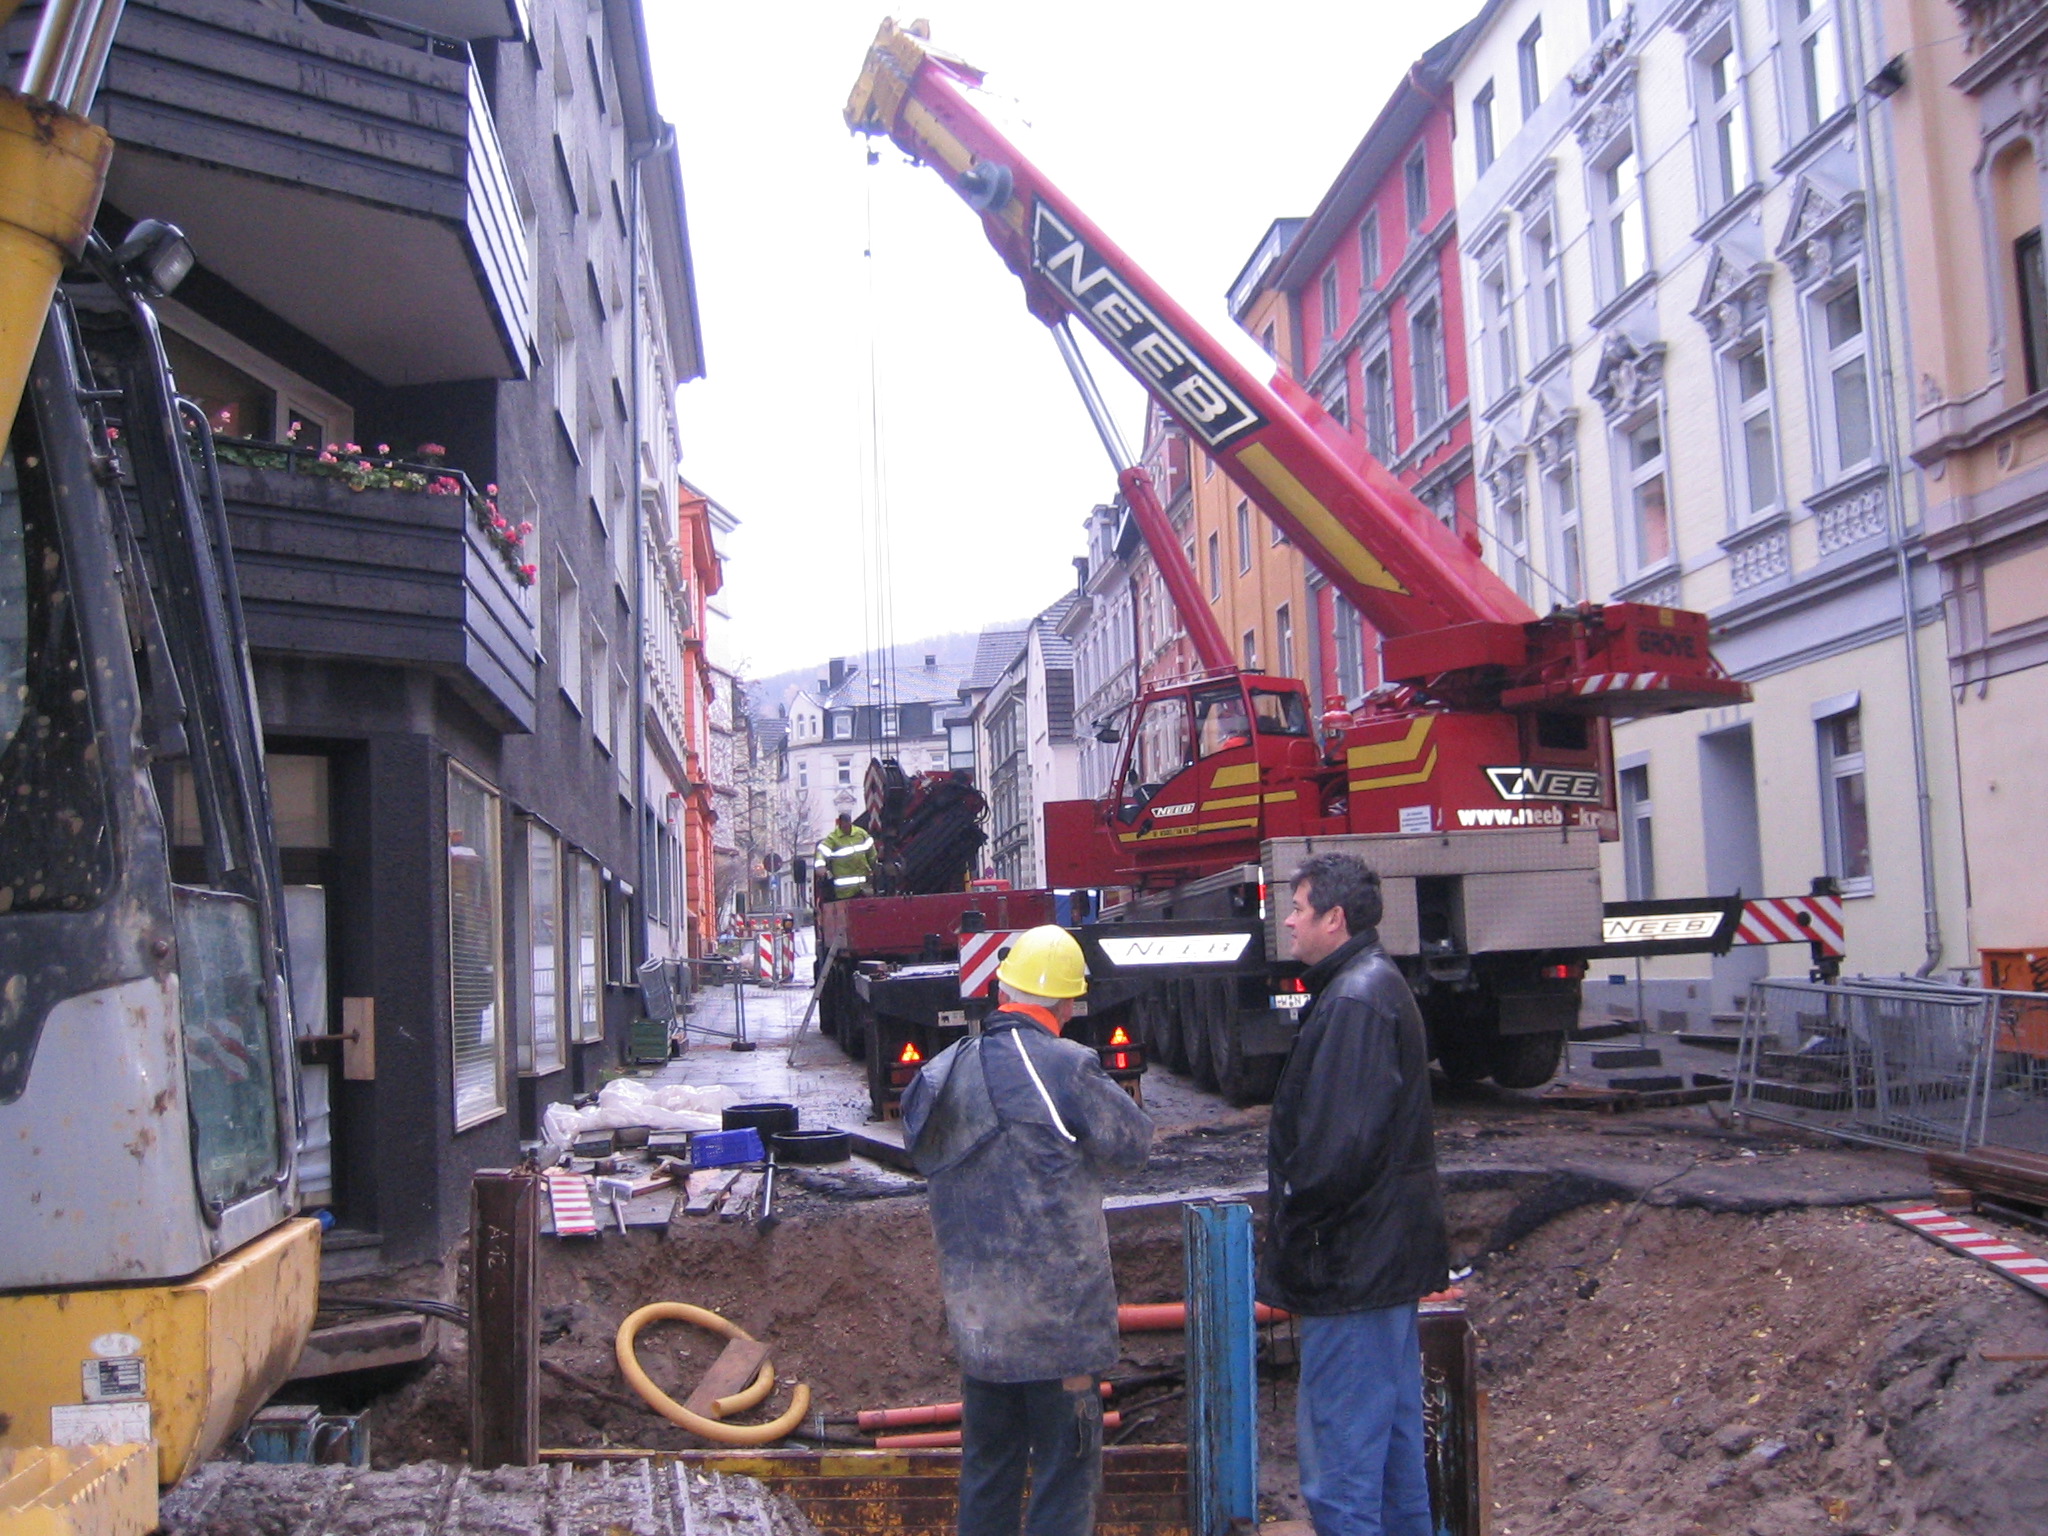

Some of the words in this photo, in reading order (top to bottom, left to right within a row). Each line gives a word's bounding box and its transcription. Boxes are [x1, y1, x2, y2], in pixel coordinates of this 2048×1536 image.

[1046, 239, 1228, 423] NEEB
[1511, 768, 1600, 796] NEE
[1609, 920, 1706, 936] NEEB
